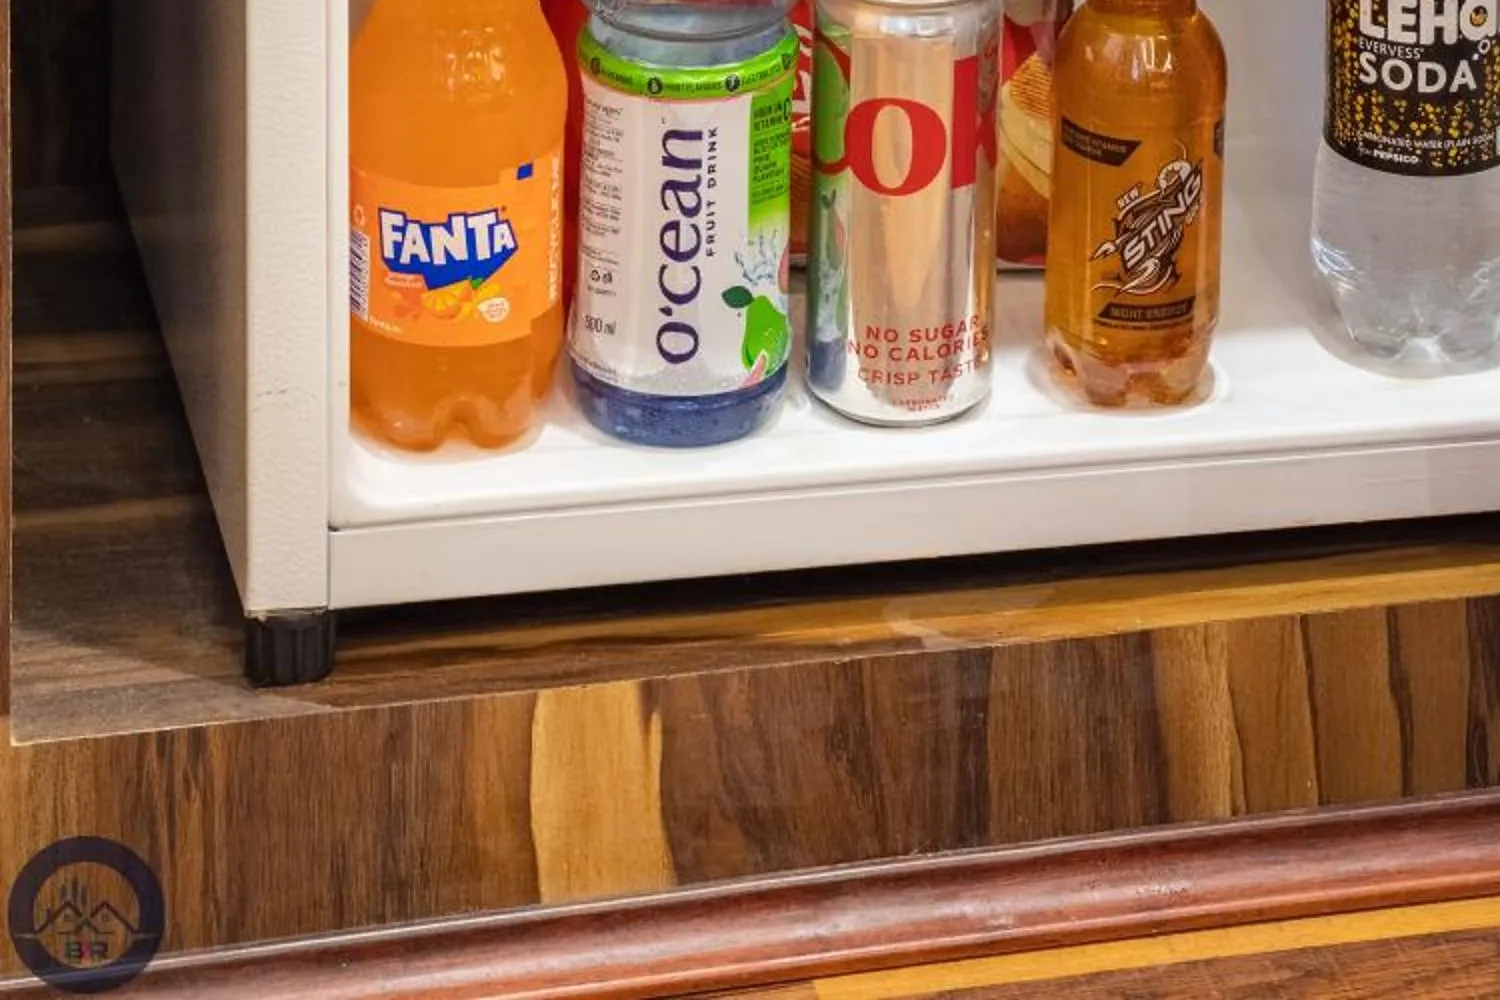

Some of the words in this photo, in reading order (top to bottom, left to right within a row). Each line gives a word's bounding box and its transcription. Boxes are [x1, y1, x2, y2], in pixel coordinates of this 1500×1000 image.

[1359, 39, 1423, 60] EVERVESS
[1358, 51, 1478, 95] SODA
[706, 126, 720, 191] DRINK
[380, 210, 515, 265] FANTA
[705, 196, 719, 258] FRUIT
[1123, 173, 1201, 270] STING
[846, 339, 879, 359] NO
[888, 325, 989, 361] CALORIES
[866, 325, 899, 343] NO
[909, 313, 980, 343] SUGAR
[858, 367, 921, 385] CRISP
